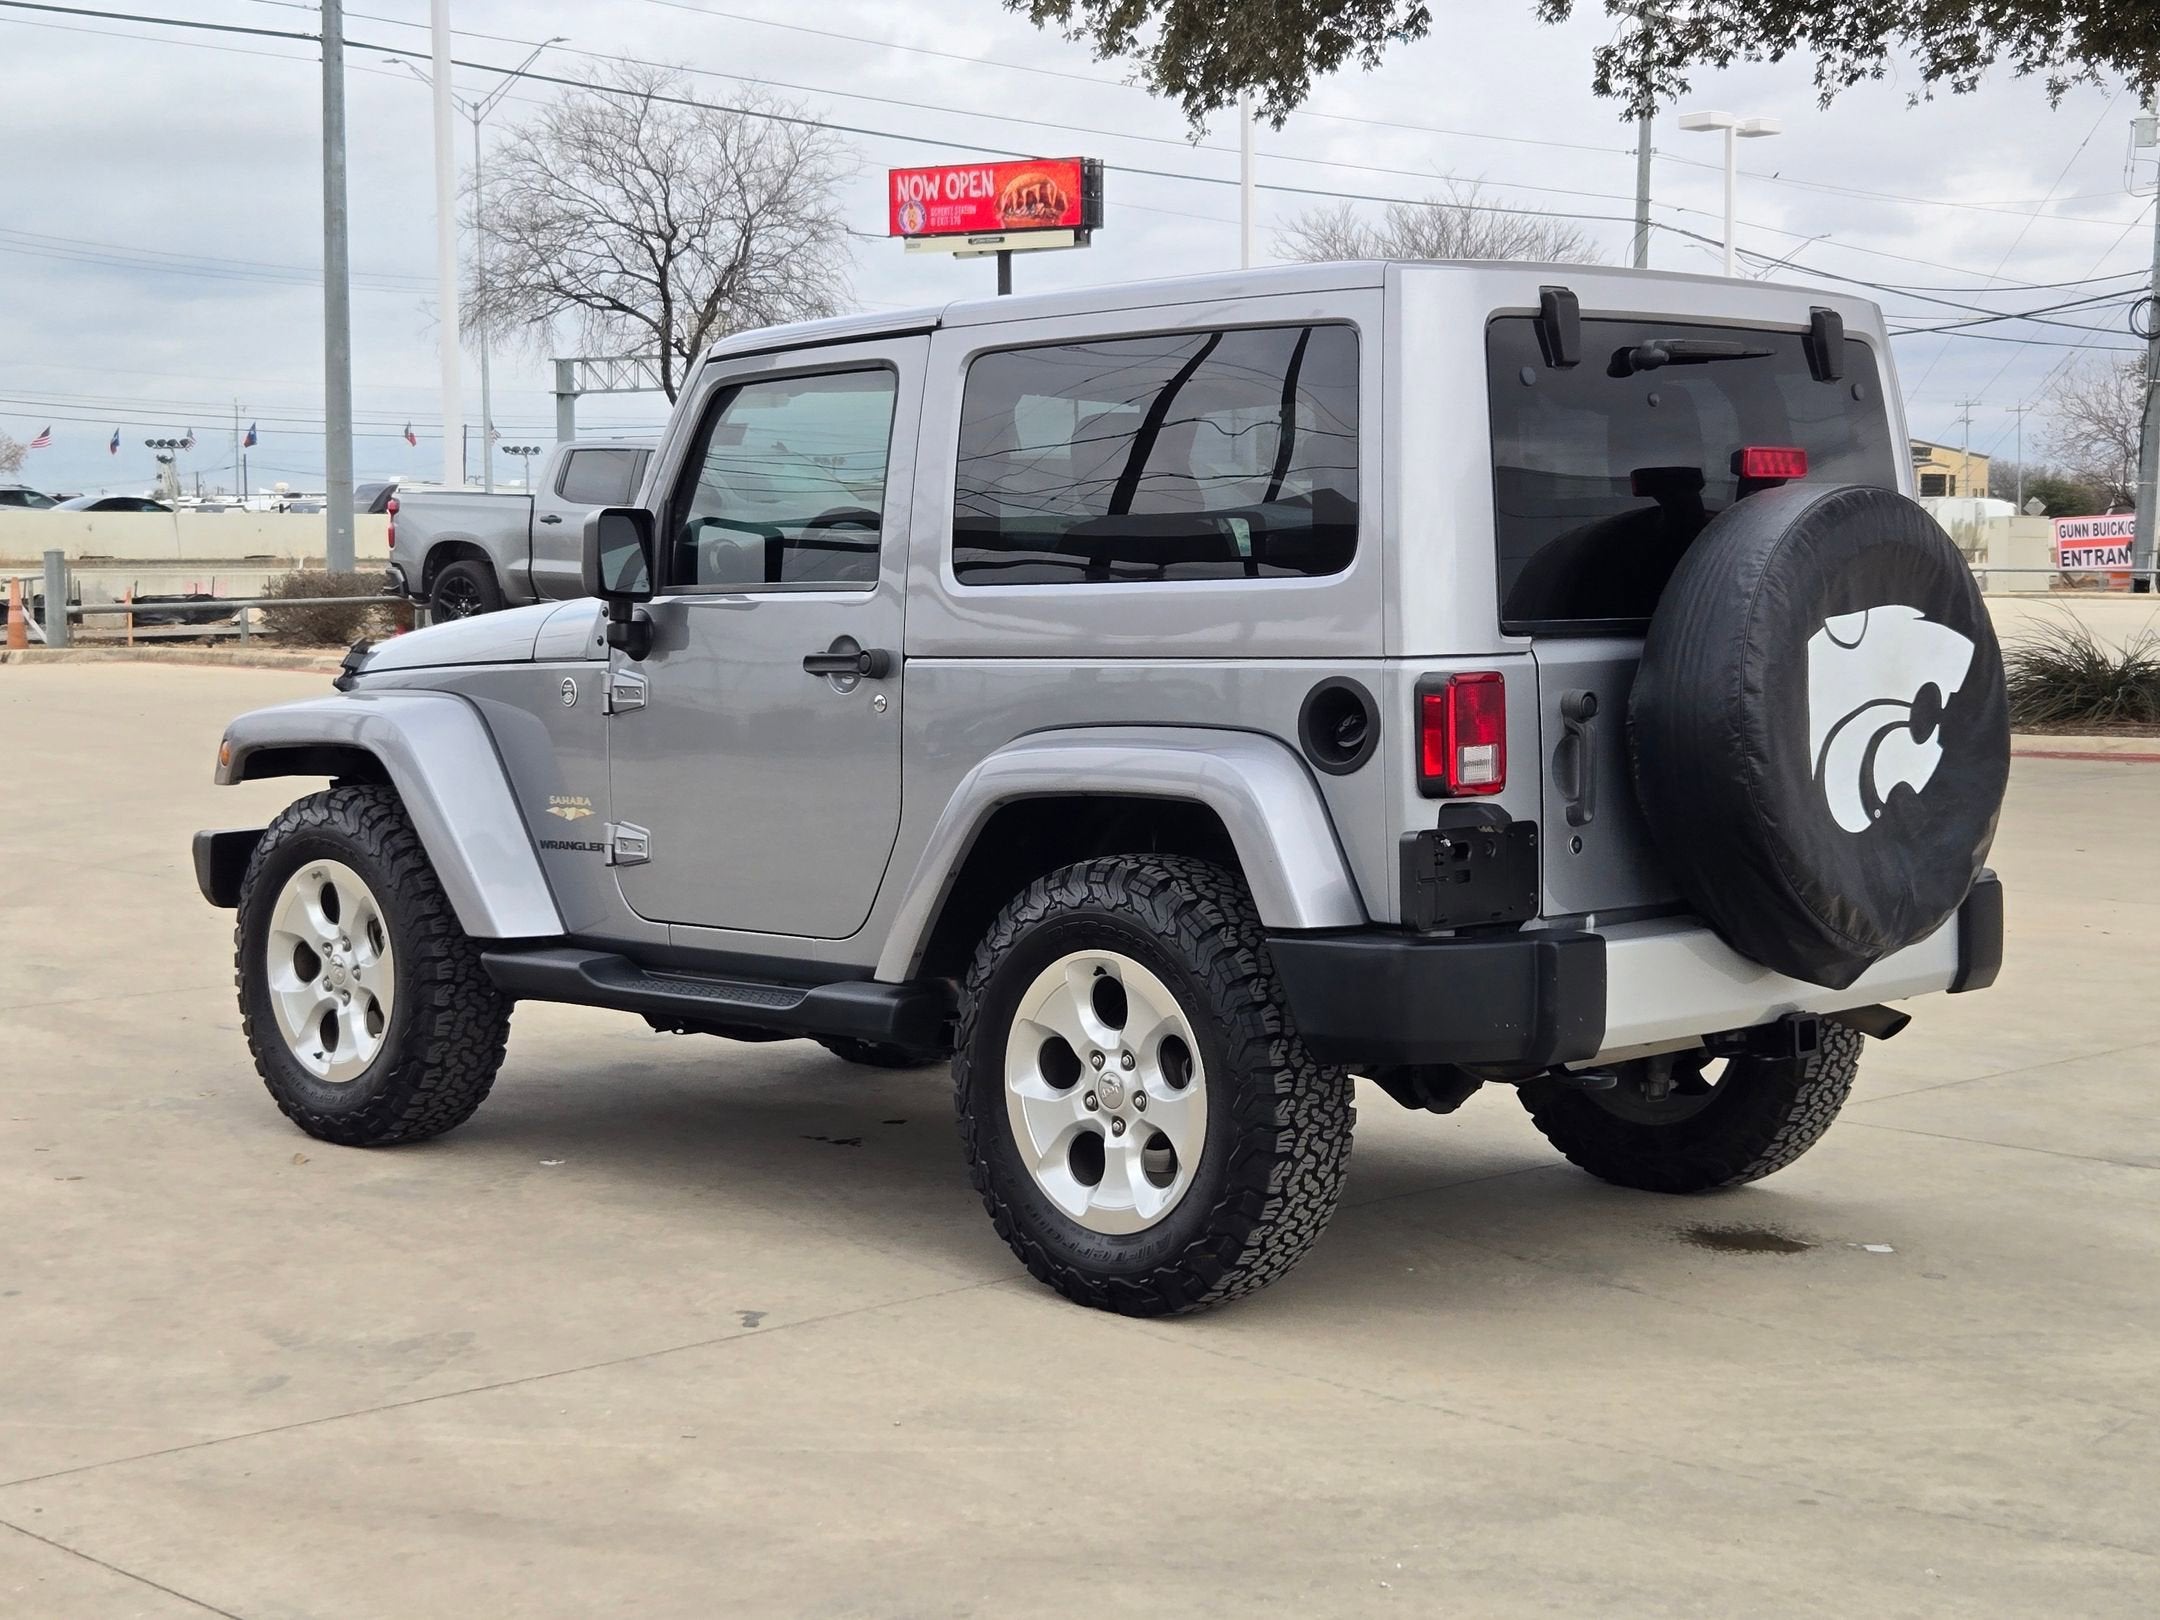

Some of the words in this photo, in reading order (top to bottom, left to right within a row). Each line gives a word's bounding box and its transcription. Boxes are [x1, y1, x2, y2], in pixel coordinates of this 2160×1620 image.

[897, 175, 940, 202] NOW
[945, 169, 995, 200] OPEN
[2059, 523, 2089, 538] GUNN
[2092, 521, 2135, 536] BUICK/G
[2061, 548, 2128, 567] ENTRAN
[549, 795, 592, 806] SAHARA
[539, 840, 605, 853] WRANGLER
